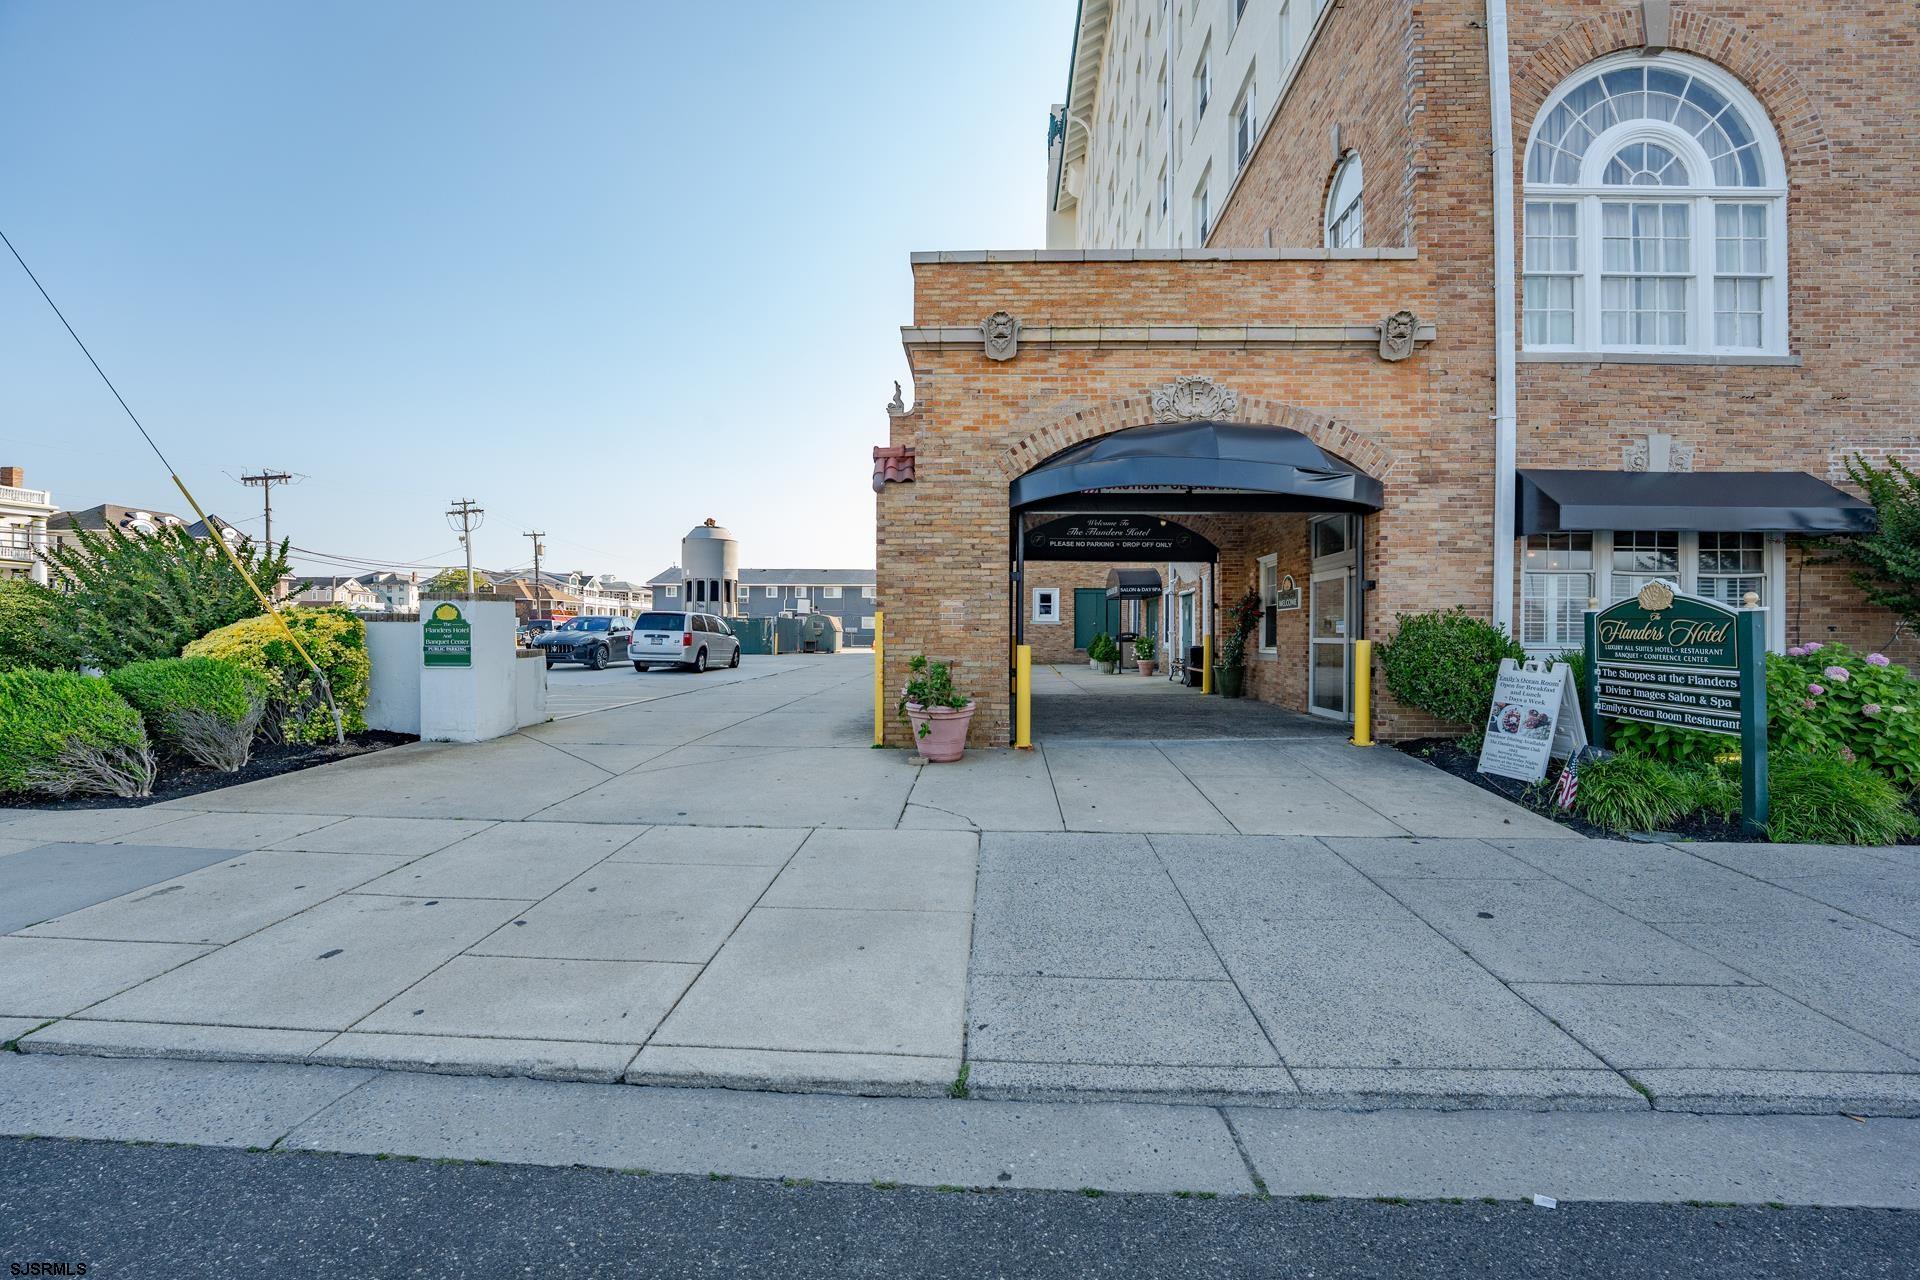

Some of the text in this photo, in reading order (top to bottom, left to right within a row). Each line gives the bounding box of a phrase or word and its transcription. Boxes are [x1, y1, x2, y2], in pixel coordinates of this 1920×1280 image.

[1066, 527, 1151, 537] The Flanders Hotel
[1599, 619, 1732, 647] Flanders Hotel
[1526, 685, 1555, 693] Breakfast
[1602, 668, 1738, 688] The Shoppes at the Flanders
[1605, 685, 1732, 709] Divine Images Salon & Spa
[1600, 702, 1740, 729] Emily's Ocean Room Restaurant
